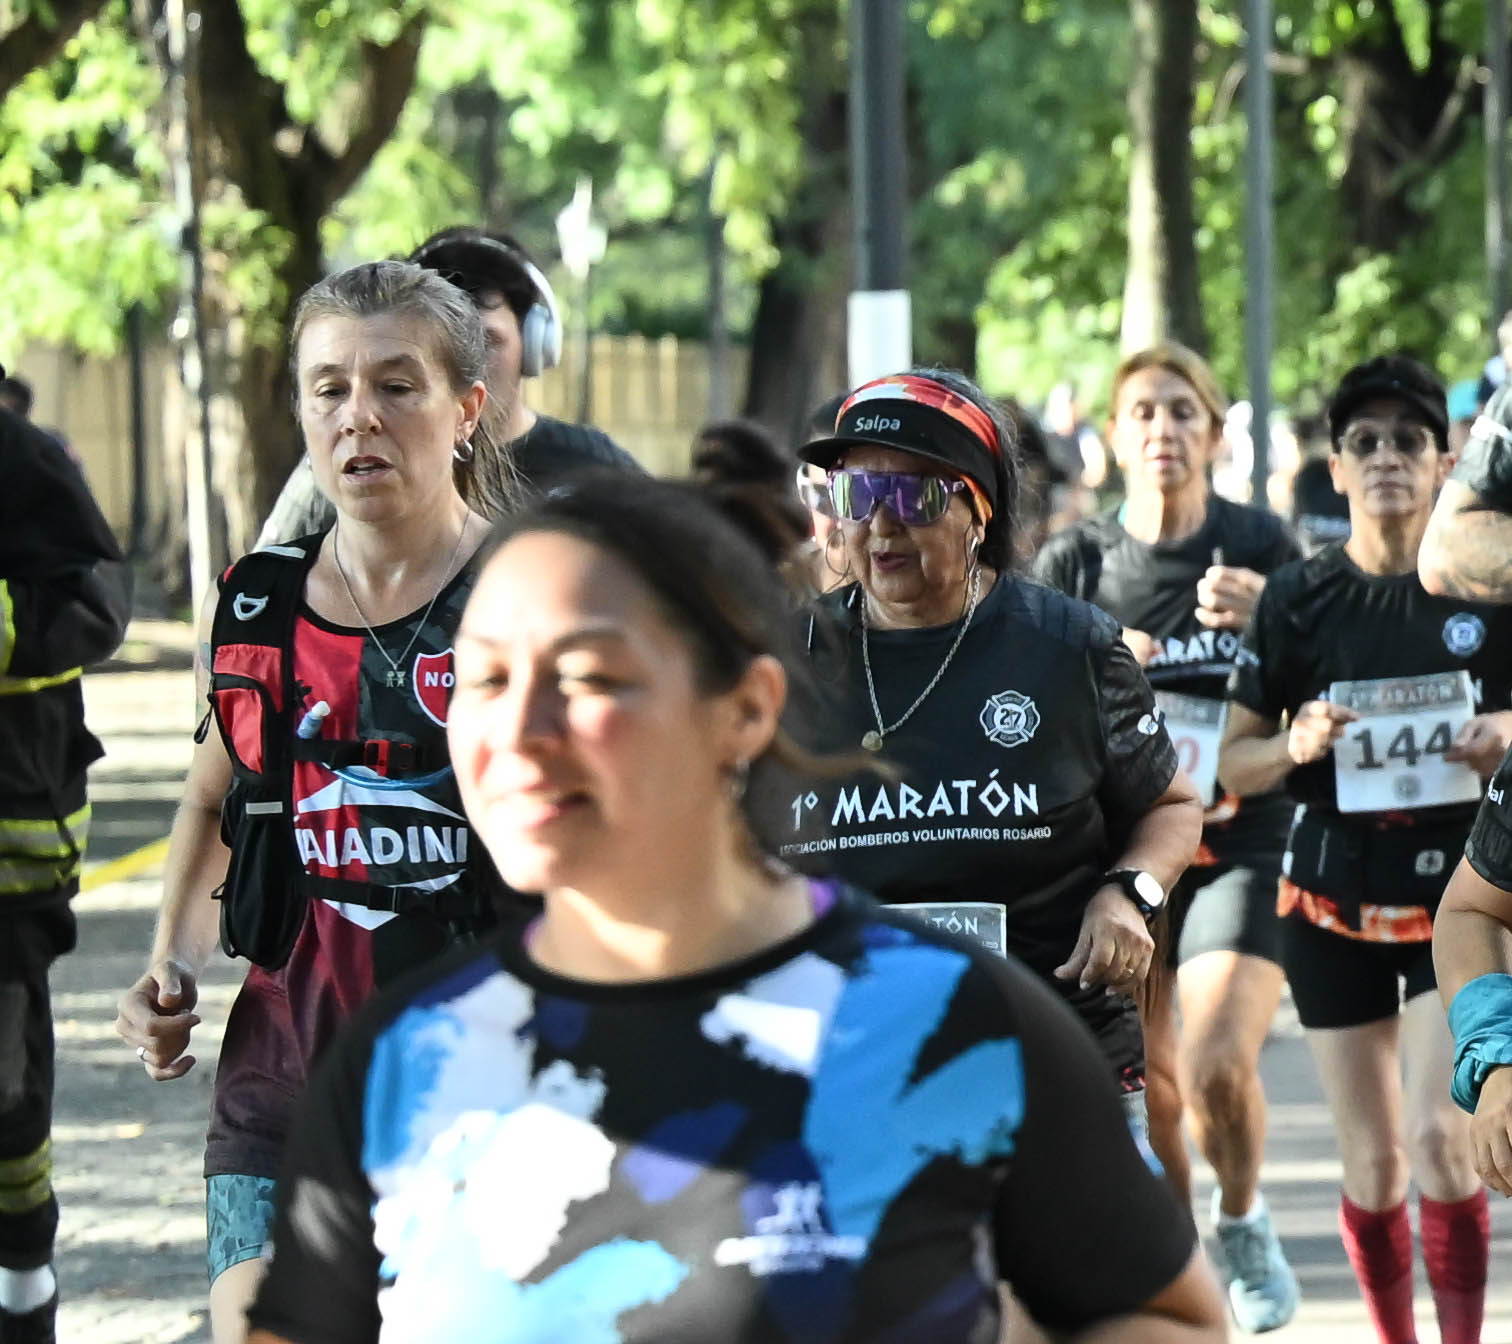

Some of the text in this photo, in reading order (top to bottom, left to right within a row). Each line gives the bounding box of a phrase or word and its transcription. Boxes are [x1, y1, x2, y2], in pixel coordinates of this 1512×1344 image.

[424, 671, 456, 688] NO
[1352, 721, 1452, 771] 144
[831, 768, 1039, 827] MARATÓN
[840, 830, 909, 849] BOMBEROS
[913, 827, 1000, 842] VOLUNTARIOS
[1003, 825, 1051, 841] ROSARIO
